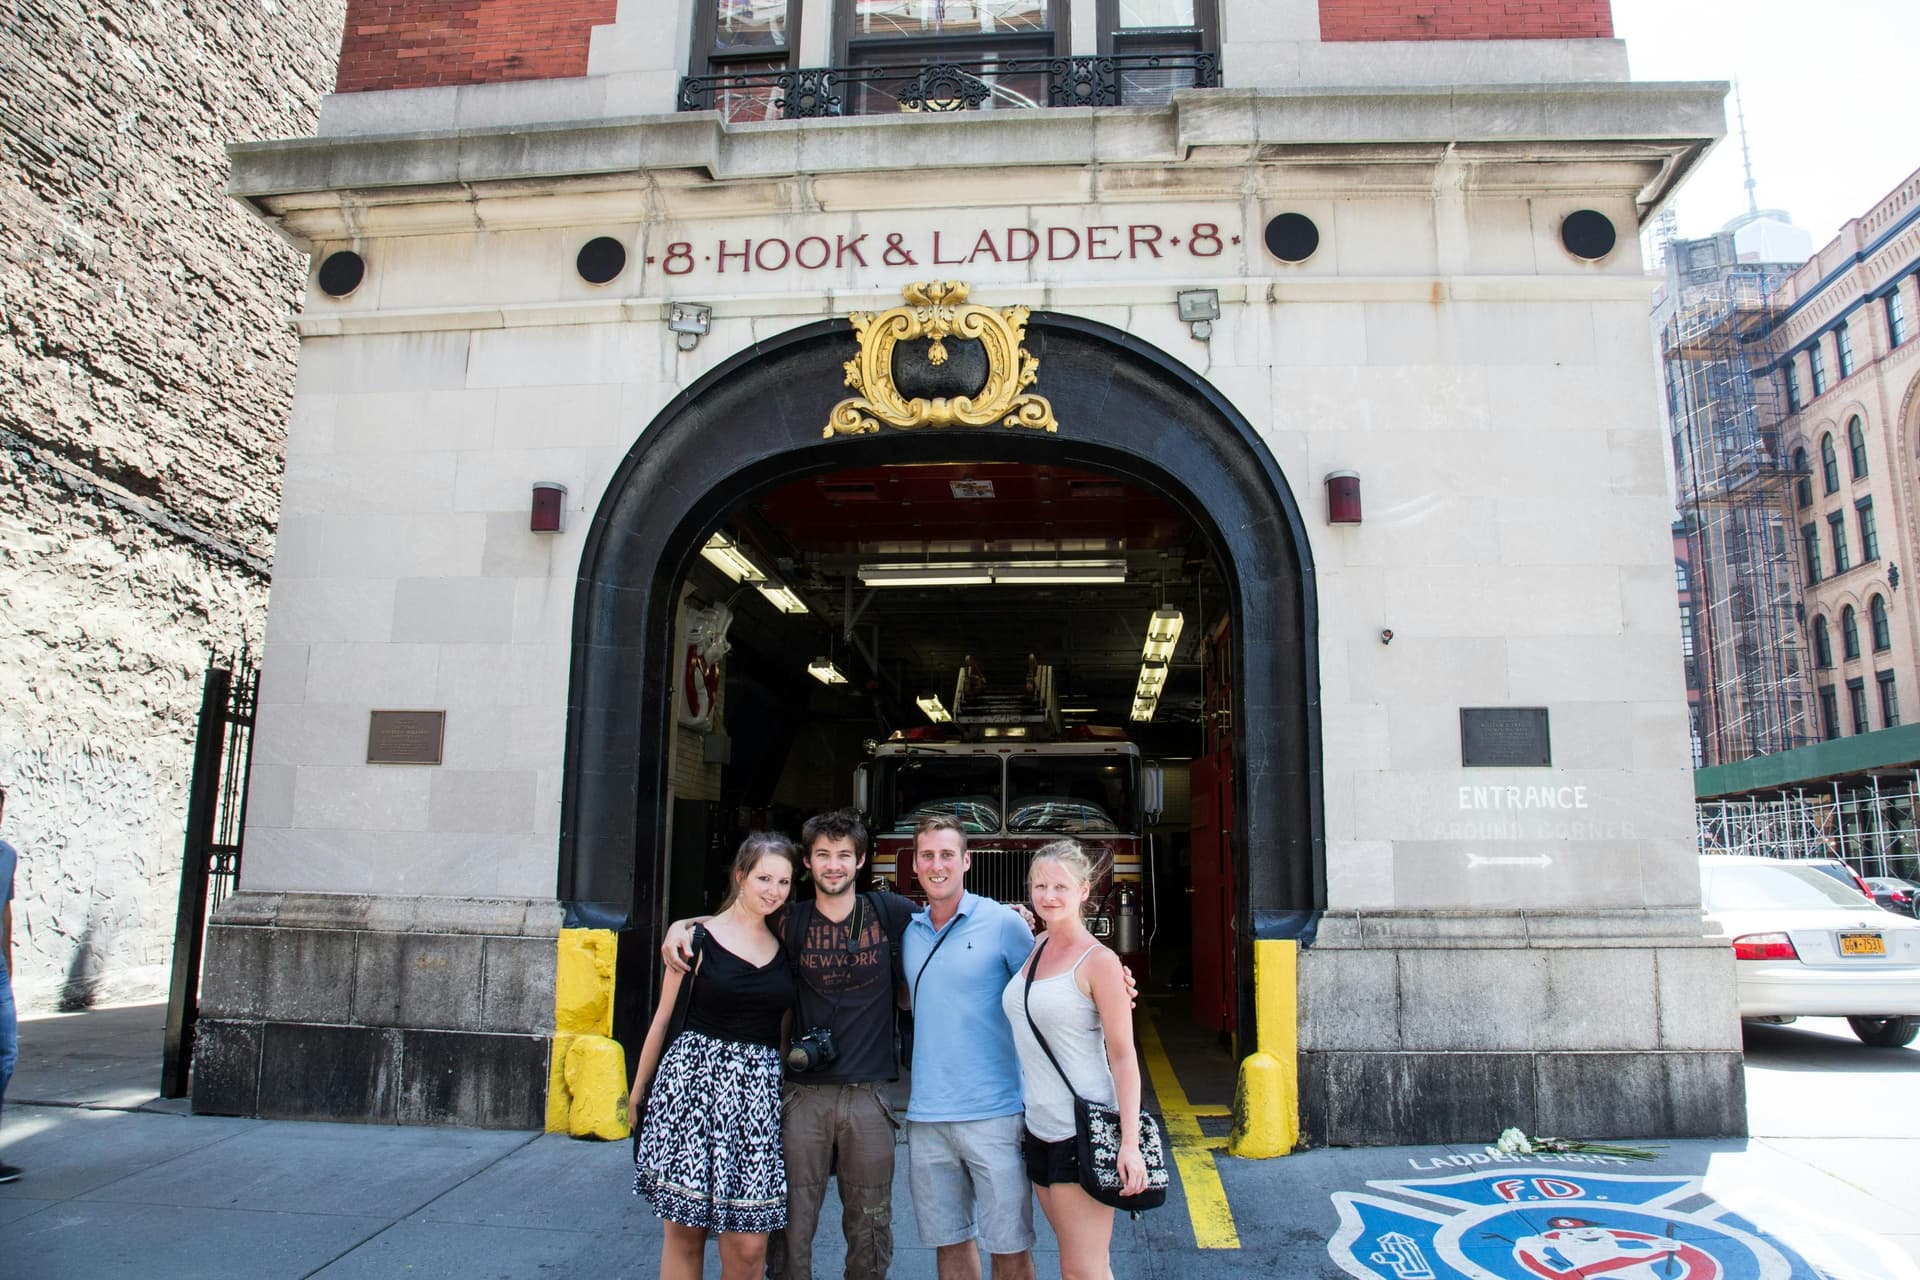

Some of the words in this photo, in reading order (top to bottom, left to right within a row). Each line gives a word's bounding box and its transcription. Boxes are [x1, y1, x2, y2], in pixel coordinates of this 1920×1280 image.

[717, 233, 869, 273] HOOK
[882, 232, 919, 266] &
[933, 223, 1164, 264] LADDER
[1458, 786, 1588, 809] ENTRANCE
[800, 952, 834, 969] NEW
[835, 949, 878, 968] YORK
